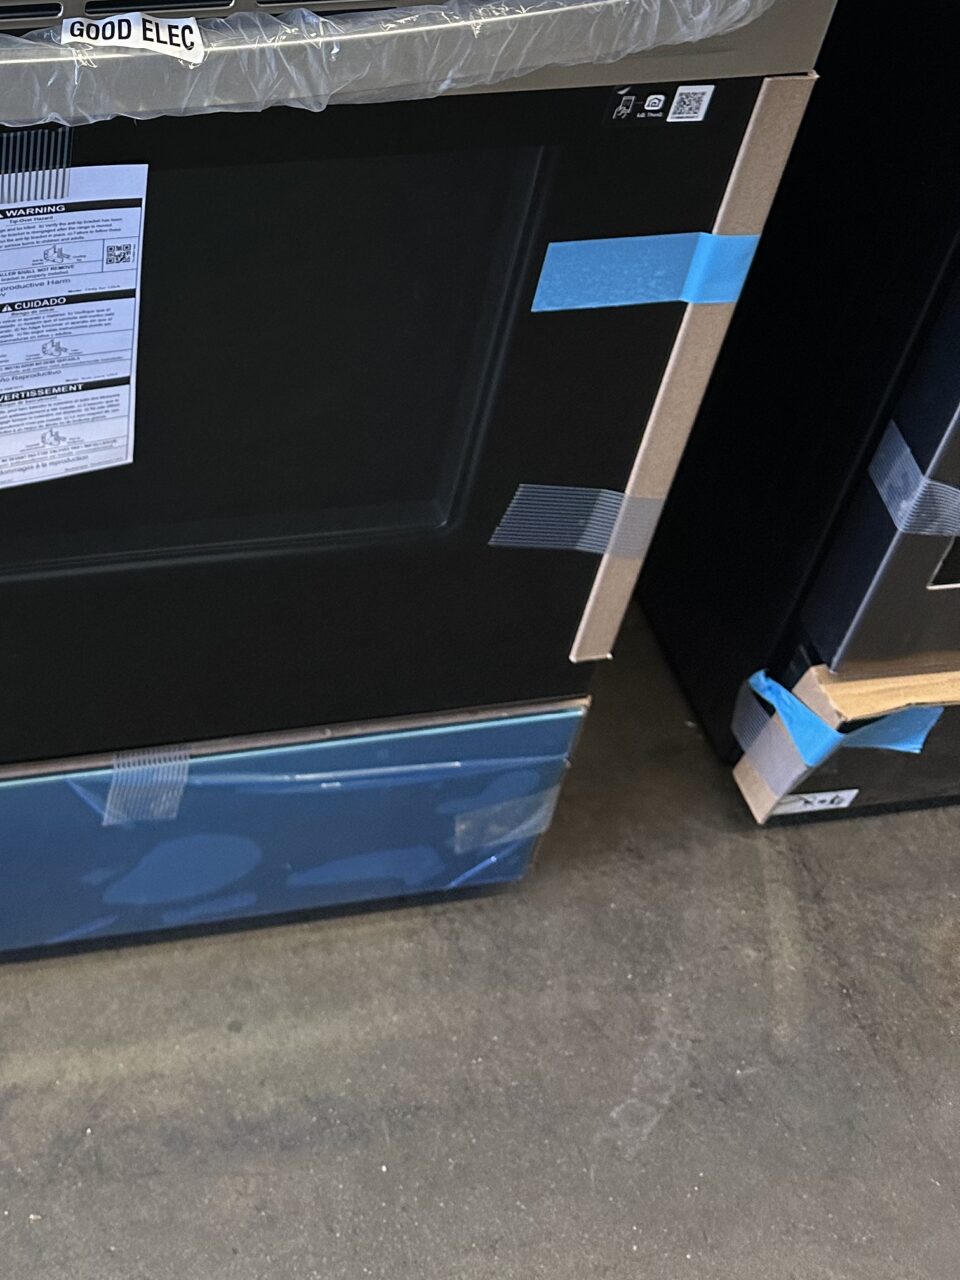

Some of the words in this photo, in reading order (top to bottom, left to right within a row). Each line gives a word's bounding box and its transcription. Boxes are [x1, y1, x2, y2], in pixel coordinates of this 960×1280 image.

[69, 19, 132, 41] GOOD
[142, 20, 196, 51] ELEC
[6, 205, 66, 218] WARNING
[47, 277, 70, 285] Harm
[14, 296, 66, 309] CUIDADO
